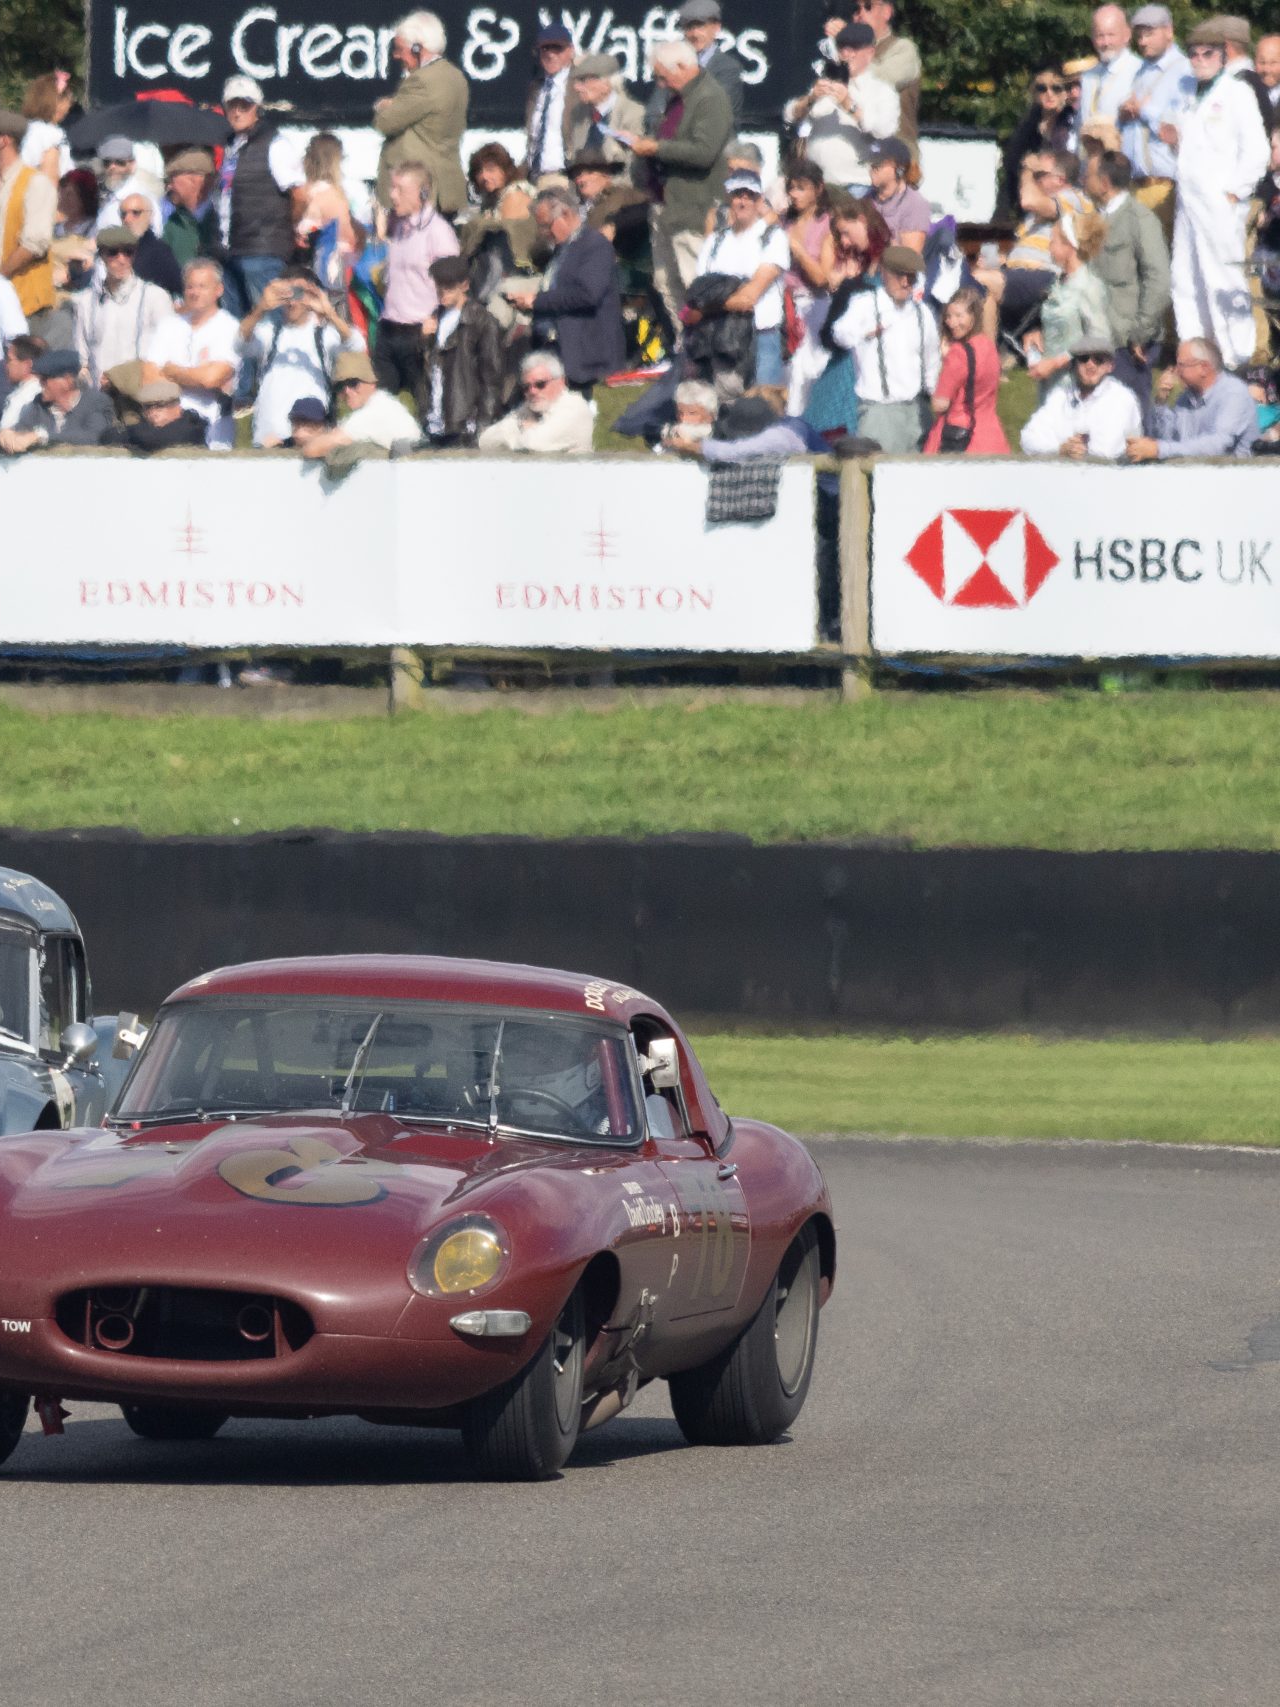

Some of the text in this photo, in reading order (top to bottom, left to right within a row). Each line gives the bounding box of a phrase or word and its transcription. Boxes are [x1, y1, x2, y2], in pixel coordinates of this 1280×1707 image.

[112, 5, 213, 79] Ice
[230, 6, 396, 80] Crea
[463, 8, 520, 81] &
[1073, 538, 1272, 585] HSBC UK
[78, 578, 305, 609] EDMISTON
[495, 582, 715, 612] EDMISTON
[1, 1319, 32, 1333] TOW
